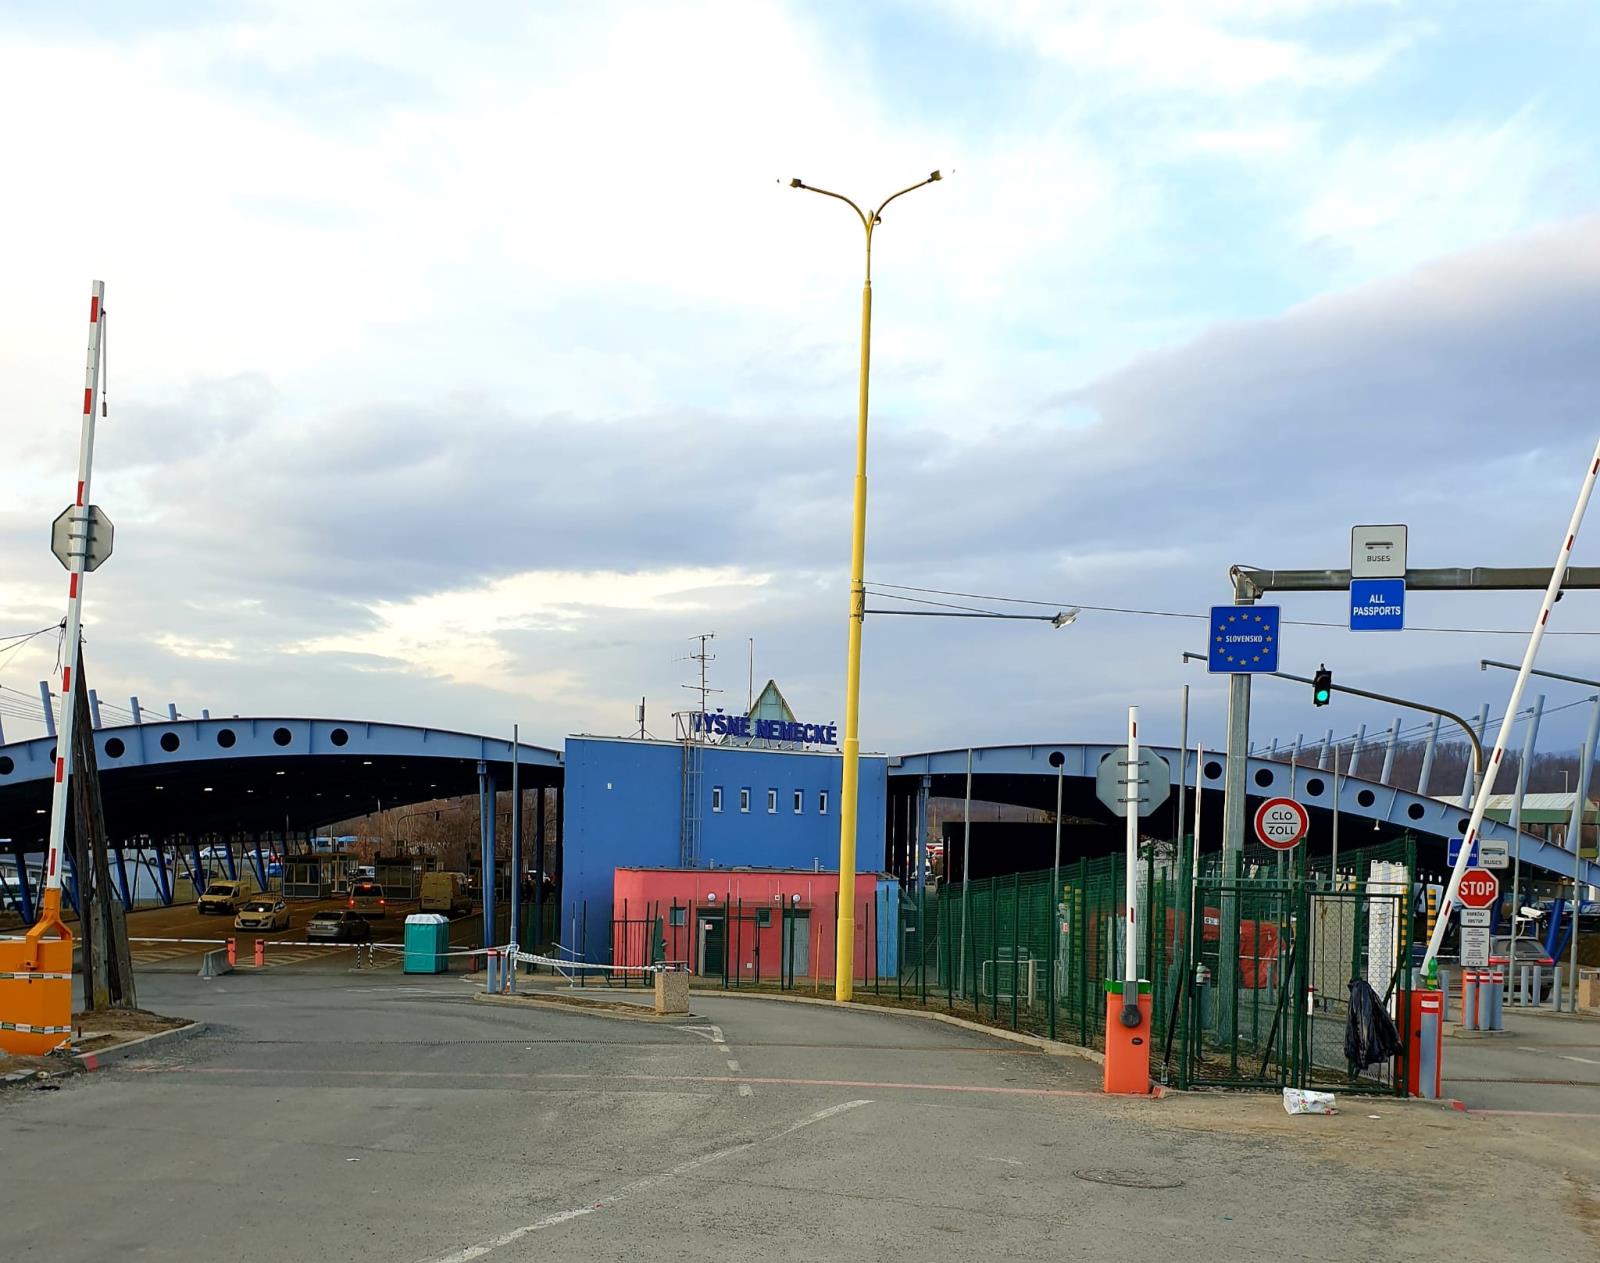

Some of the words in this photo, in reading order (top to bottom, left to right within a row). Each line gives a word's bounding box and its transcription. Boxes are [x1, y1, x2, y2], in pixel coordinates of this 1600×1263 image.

[1369, 594, 1385, 603] ALL
[1353, 606, 1401, 615] PASSPORTS
[1225, 635, 1263, 643] SLOVENSKO
[691, 708, 751, 737] VYŠNÉ
[756, 719, 837, 746] NEMECKÉ
[1272, 811, 1293, 820] CLO
[1268, 826, 1295, 834] ZOLL
[1460, 881, 1494, 895] STOP
